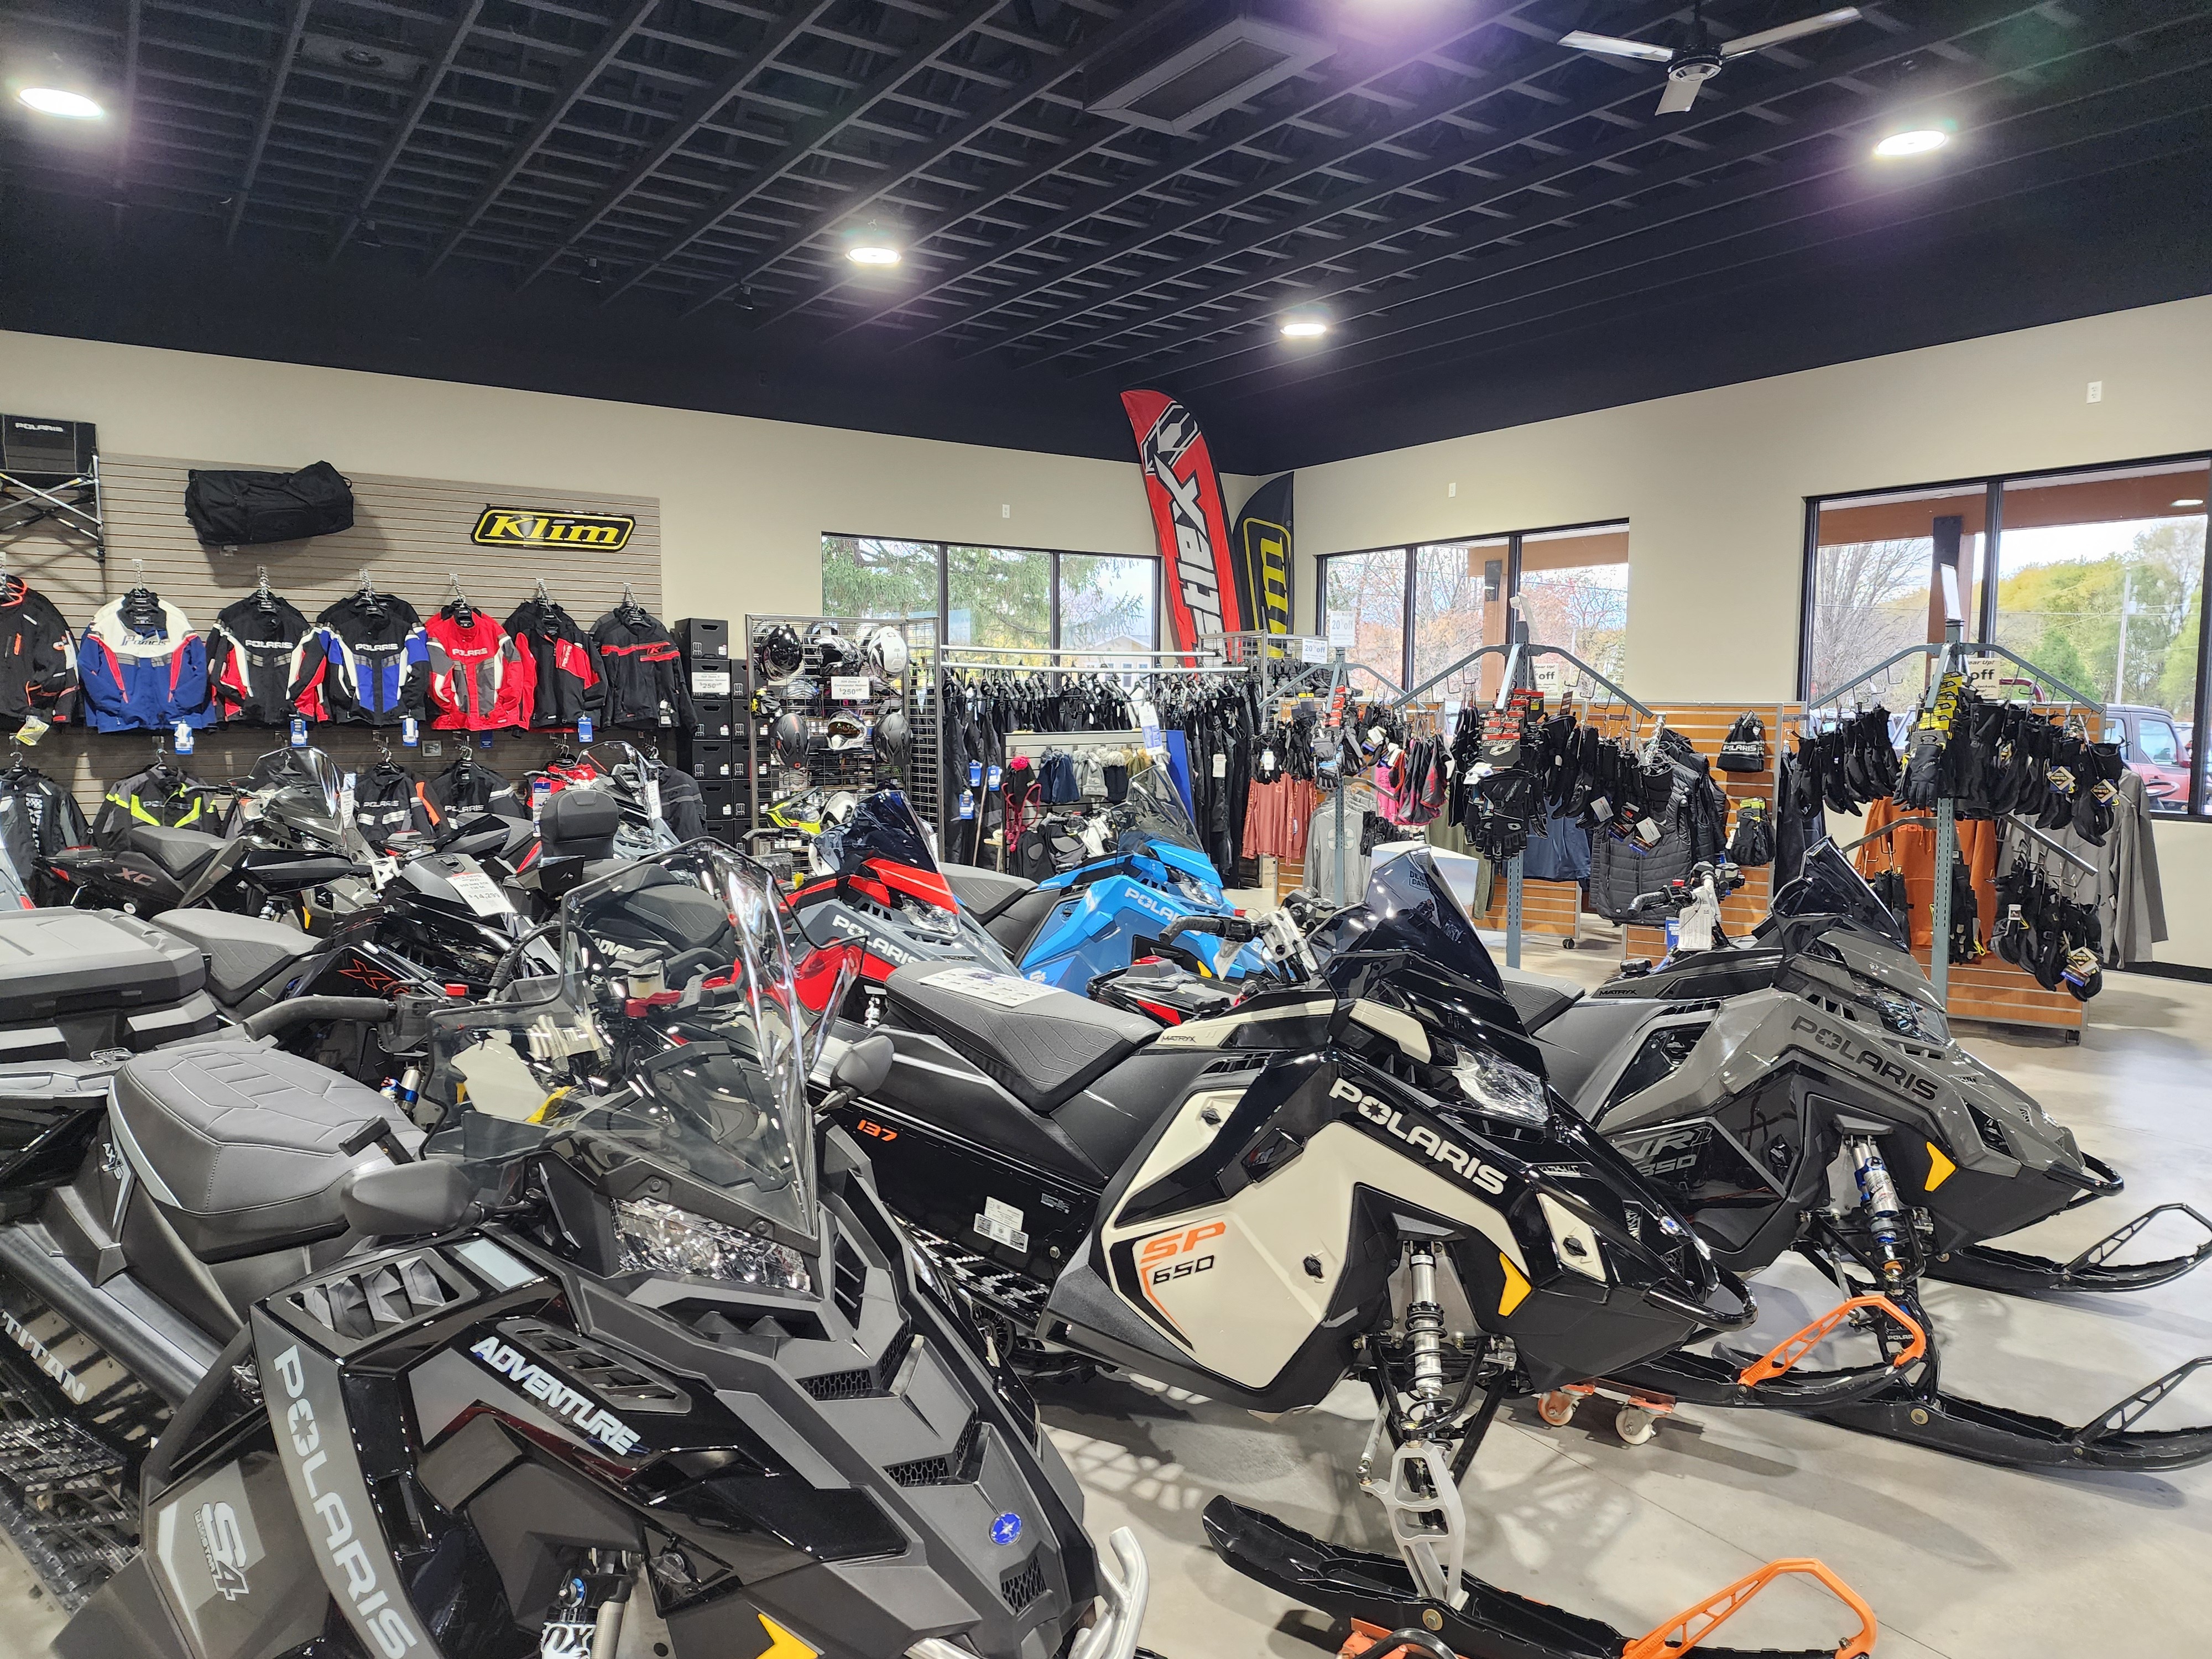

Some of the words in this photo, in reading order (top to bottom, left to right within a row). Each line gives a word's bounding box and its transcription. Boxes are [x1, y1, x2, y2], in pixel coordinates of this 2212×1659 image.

[244, 639, 294, 649] POLARIS
[354, 643, 399, 651] POLARIS
[452, 648, 488, 656] POLARIS
[1538, 671, 1556, 680] off
[1970, 669, 1995, 681] off
[1124, 886, 1179, 922] POLA
[1790, 1015, 1939, 1100] POLARIS
[857, 1119, 899, 1142] 137
[1329, 1077, 1509, 1195] POLARIS
[1139, 1221, 1227, 1265] SP
[1152, 1254, 1215, 1285] 650
[1, 1310, 86, 1403] TITAN
[469, 1335, 641, 1457] ADVENTURE
[273, 1344, 419, 1659] POLARIS
